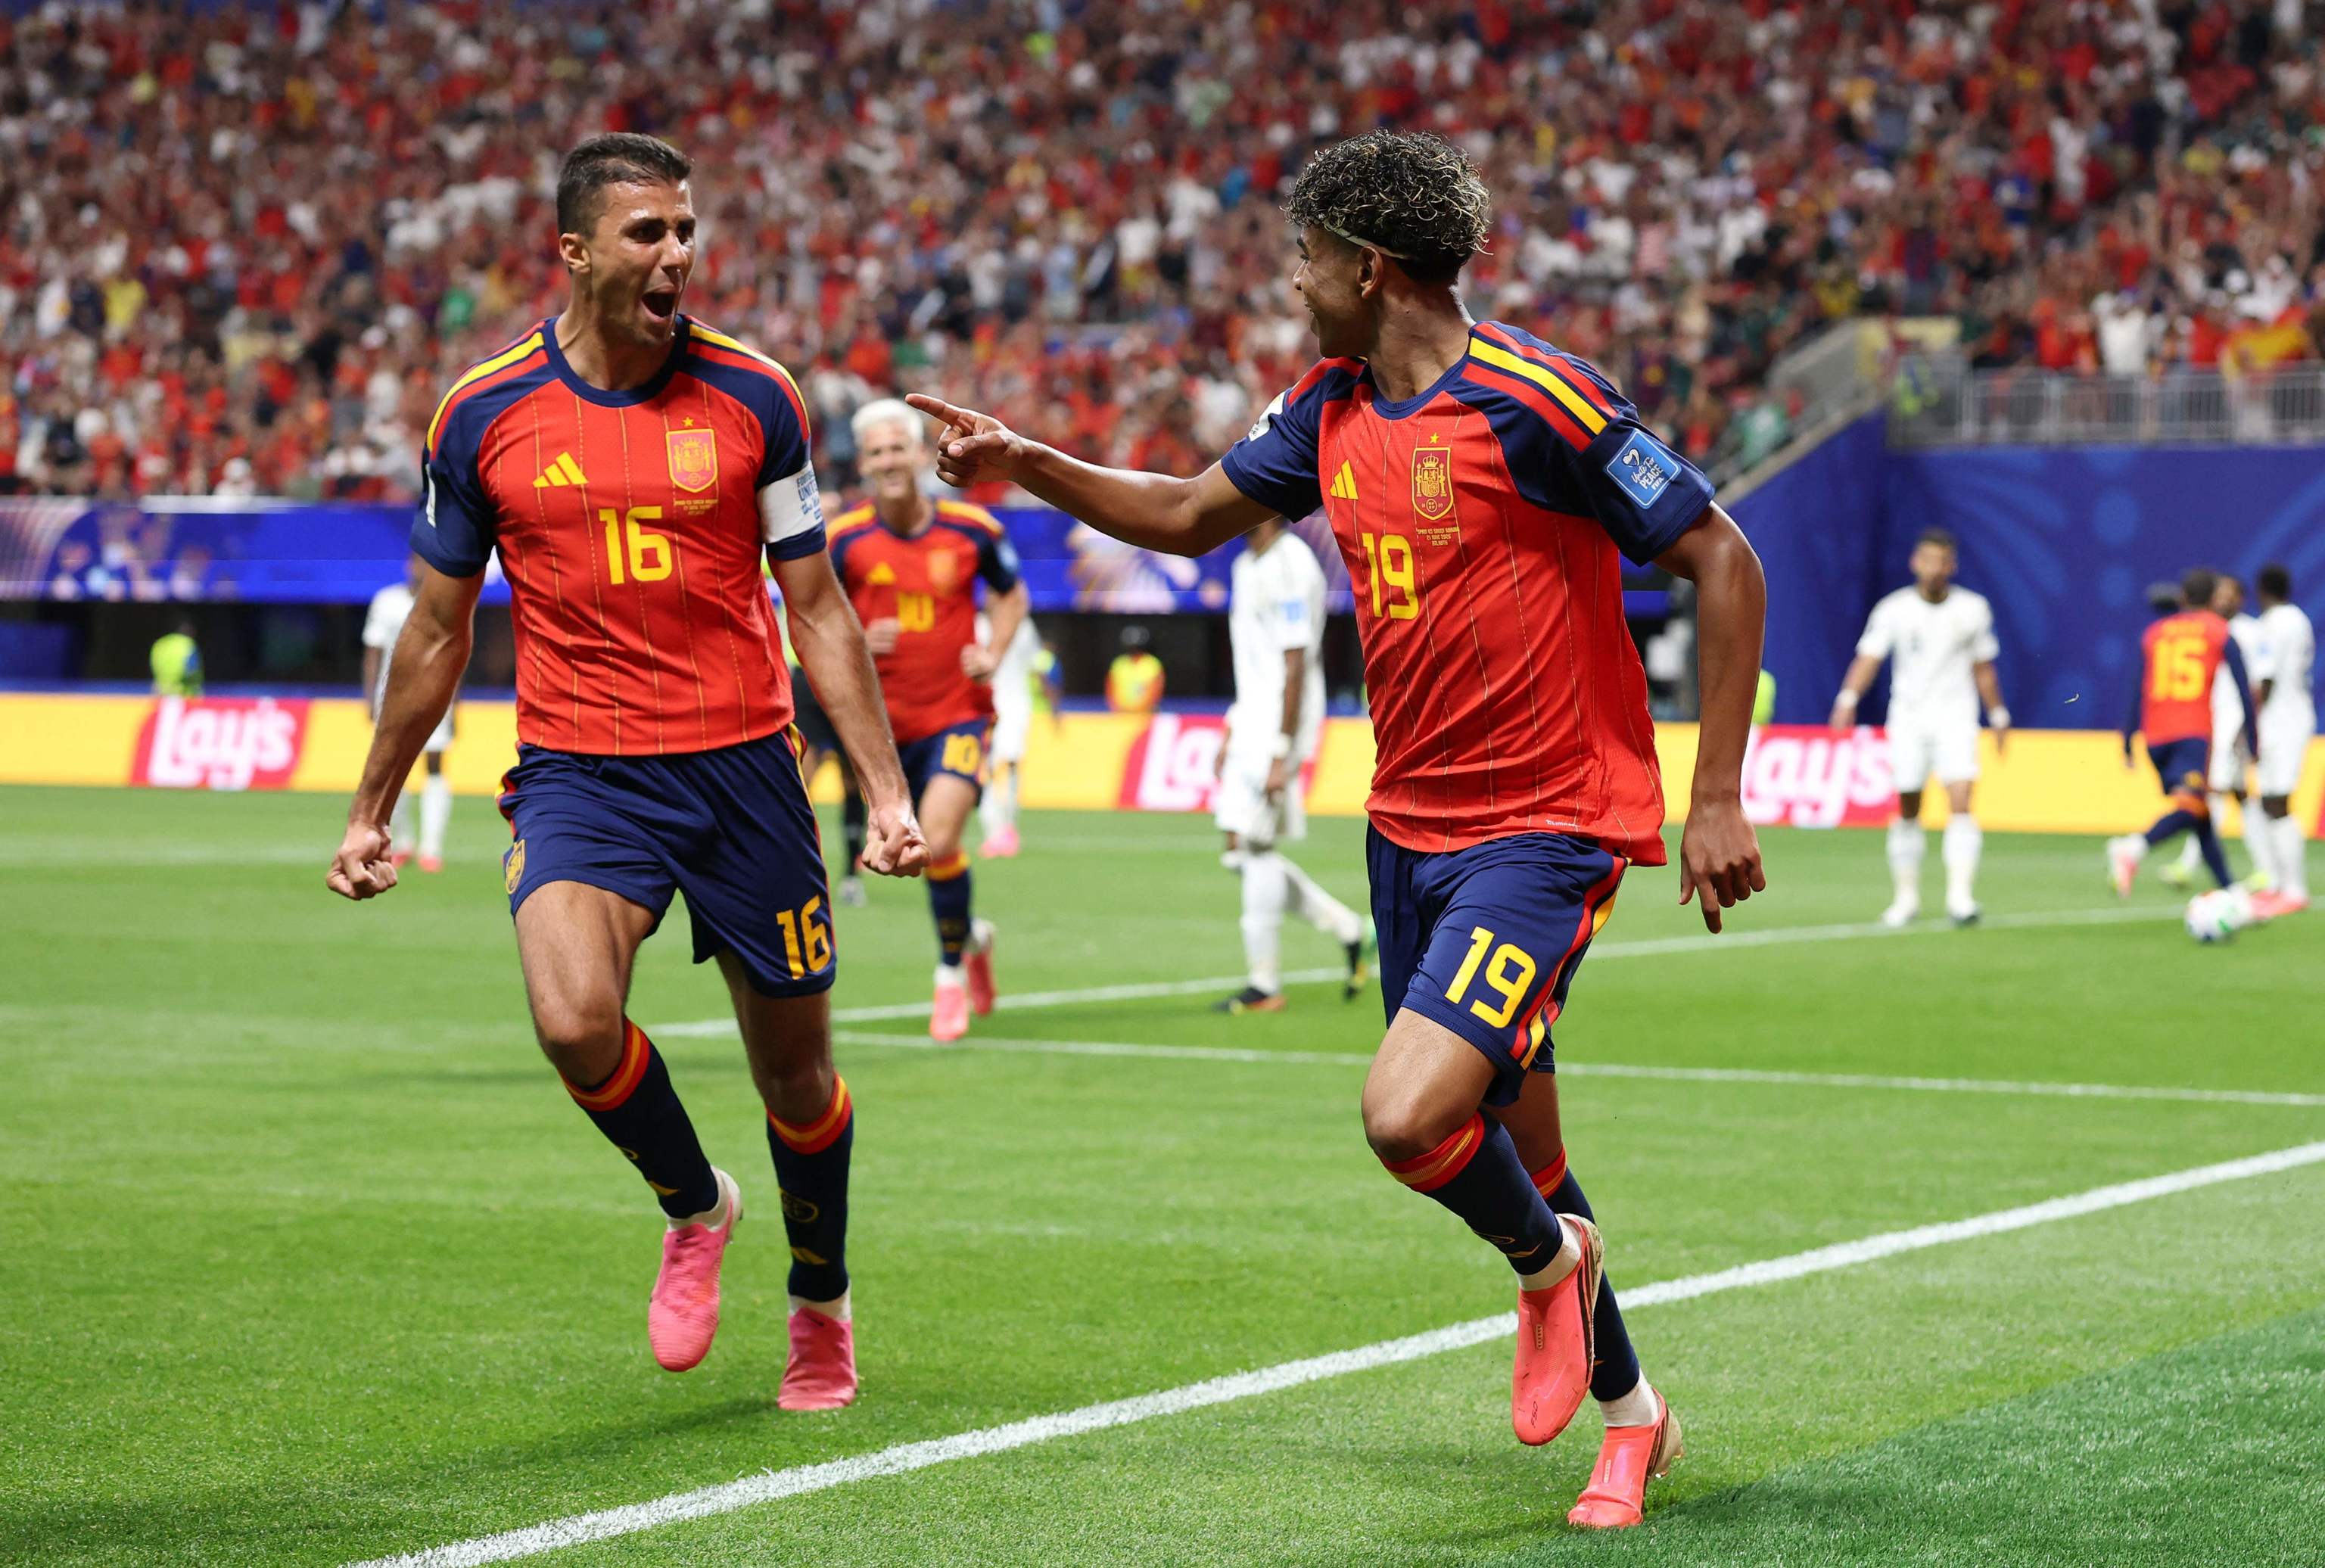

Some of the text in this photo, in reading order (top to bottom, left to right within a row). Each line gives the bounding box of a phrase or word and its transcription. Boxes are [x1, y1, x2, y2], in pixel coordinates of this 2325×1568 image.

[1631, 464, 1648, 484] Unite
[1639, 464, 1664, 490] PEACE
[1651, 478, 1665, 490] FIFA
[599, 506, 672, 585] 16
[1362, 532, 1419, 620] 19
[897, 591, 935, 633] 10
[2154, 637, 2208, 701] 15
[148, 695, 297, 791] Lay's
[942, 733, 981, 776] 10
[776, 894, 832, 981] 16
[1444, 926, 1536, 1029] 19
